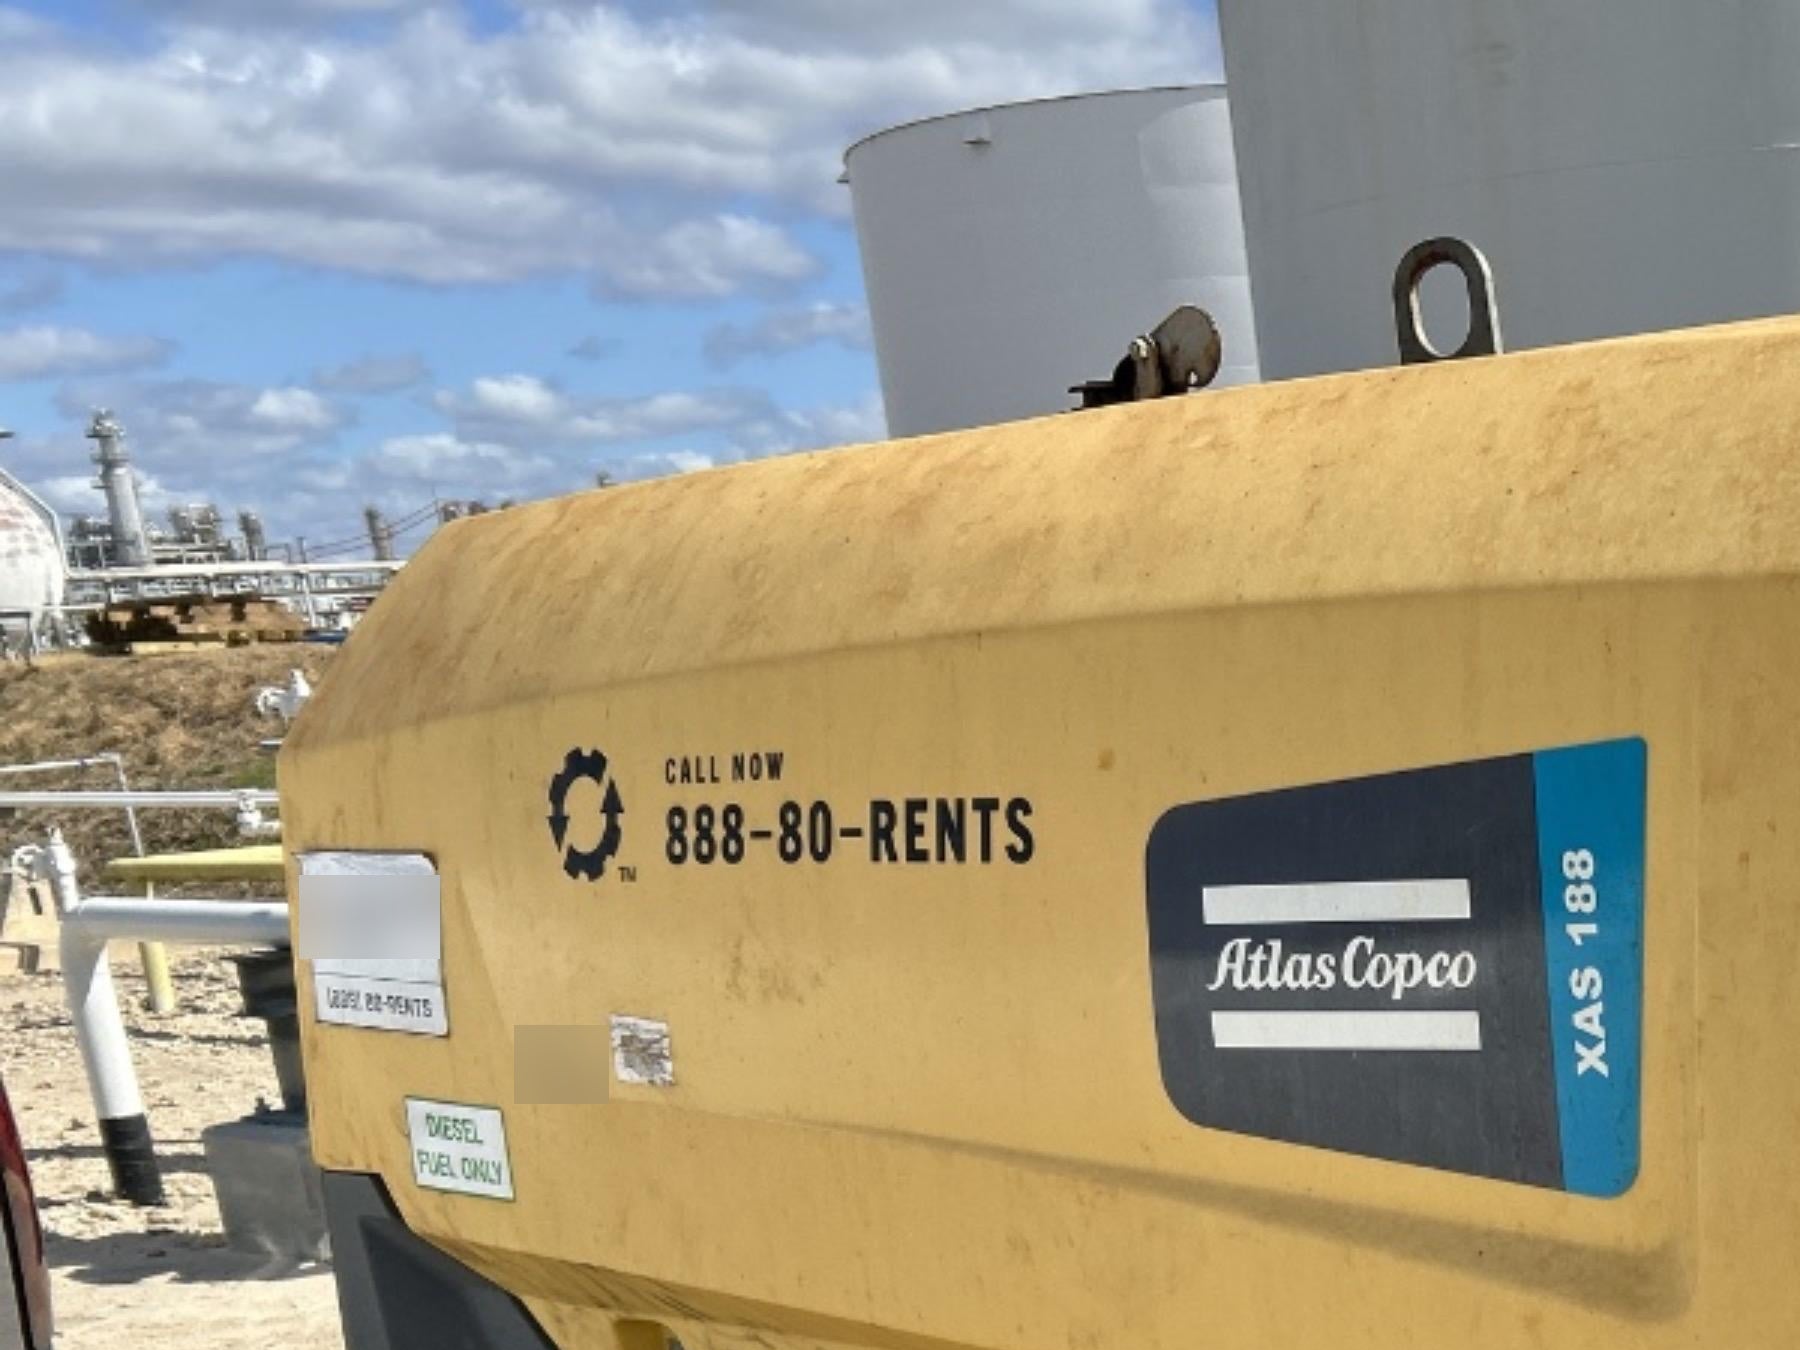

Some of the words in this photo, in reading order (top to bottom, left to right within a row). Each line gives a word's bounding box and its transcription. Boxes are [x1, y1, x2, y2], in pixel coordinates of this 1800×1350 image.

[664, 755, 720, 784] CALL
[731, 751, 784, 781] NOW
[665, 797, 1034, 865] 888-80-RENTS
[1562, 847, 1598, 947] 188
[1207, 937, 1336, 991] Atlas
[1342, 935, 1476, 999] Copco
[1569, 966, 1609, 1078] XAS
[425, 1112, 483, 1145] DIESEL
[416, 1149, 459, 1179] FUEL
[461, 1156, 502, 1185] ONLY
